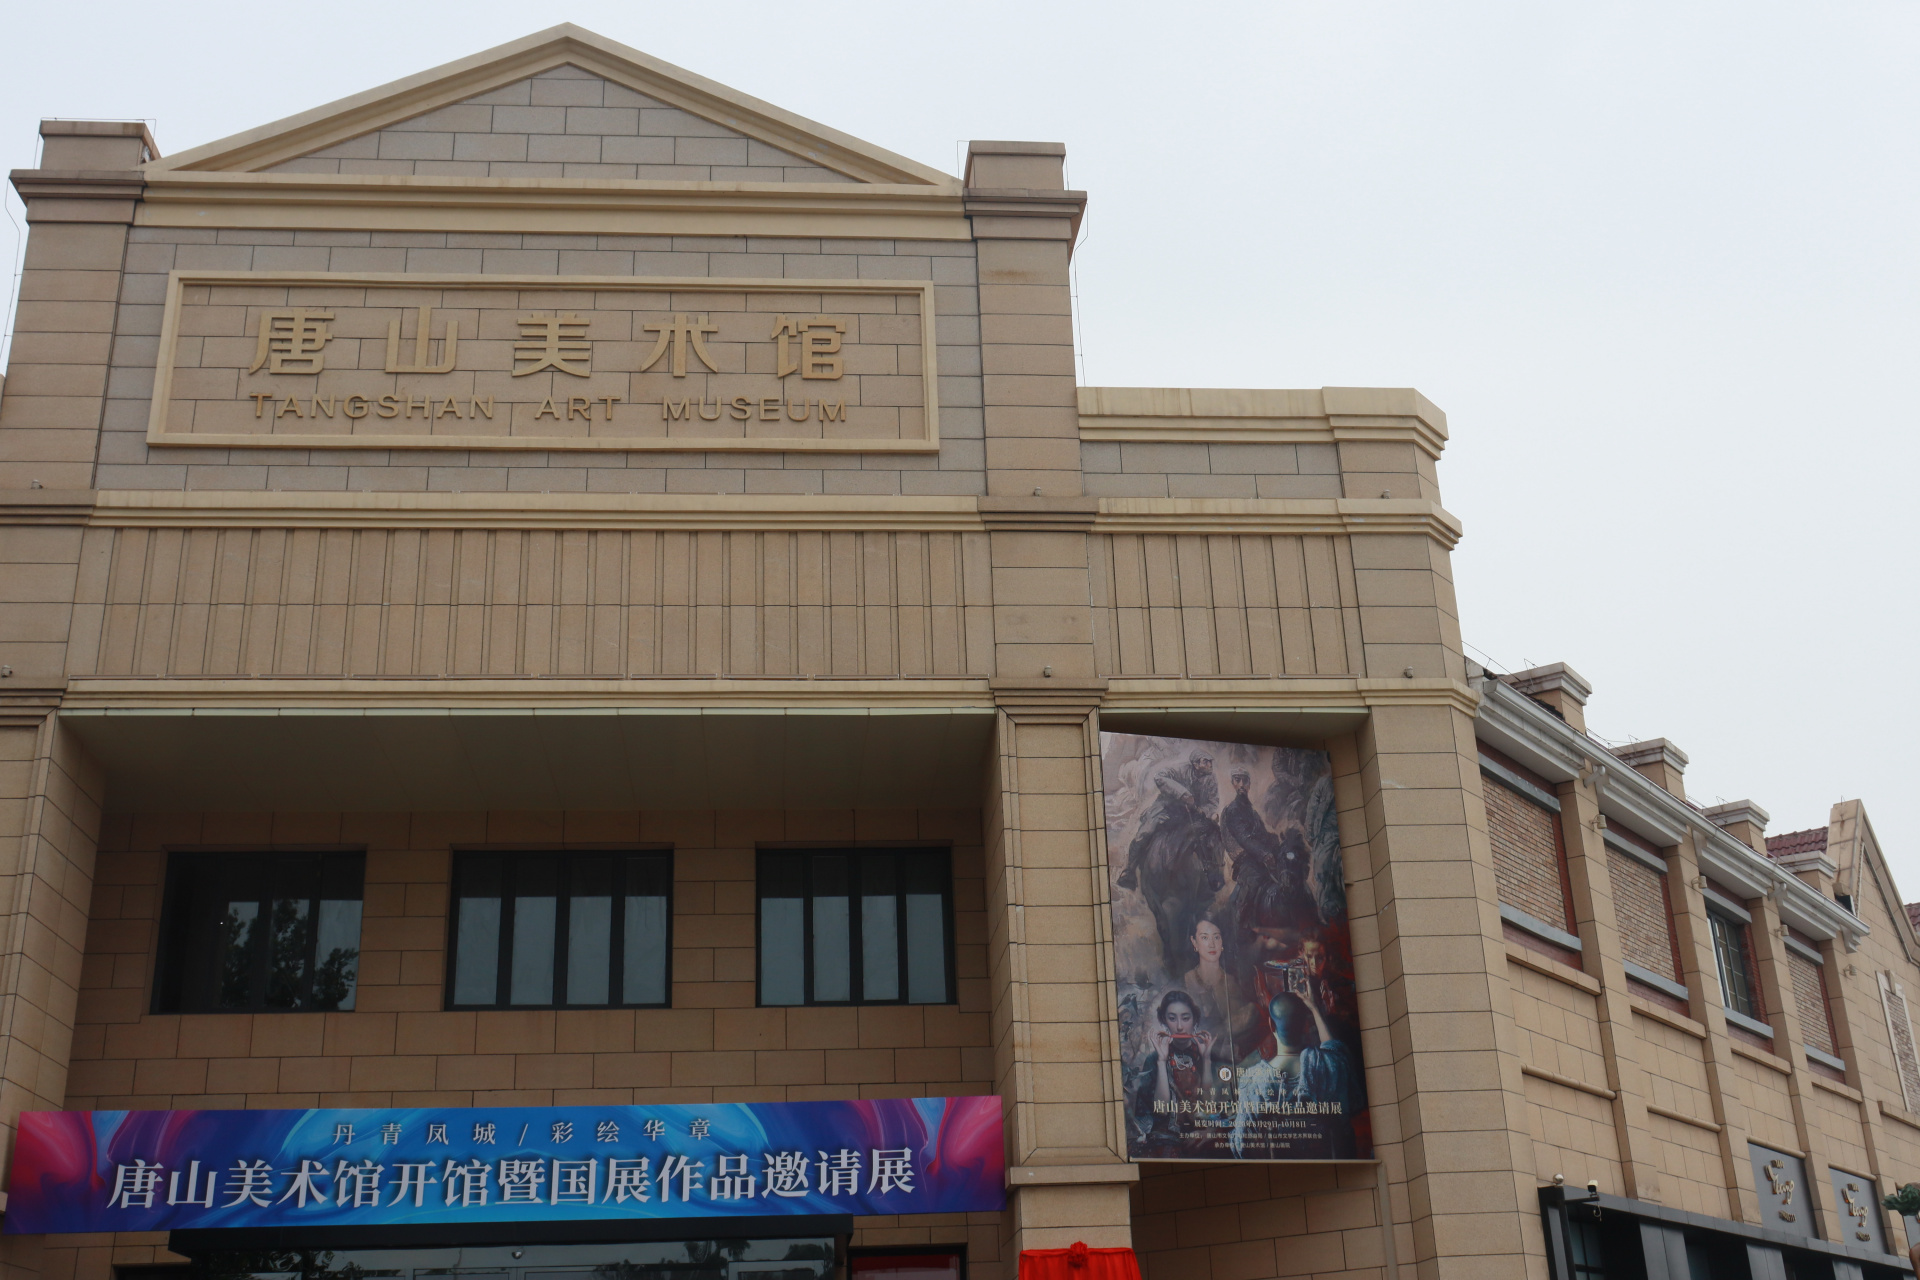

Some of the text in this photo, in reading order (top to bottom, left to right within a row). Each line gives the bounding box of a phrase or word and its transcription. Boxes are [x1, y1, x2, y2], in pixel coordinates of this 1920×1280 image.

[247, 305, 848, 381] 唐山美术馆
[249, 391, 848, 422] TANGSHAN ART MUSEUM
[1153, 1099, 1343, 1116] 唐山美术馆开馆暨国展作品邀请展
[106, 1146, 915, 1209] 唐山美术馆开馆暨国展作品邀请展
